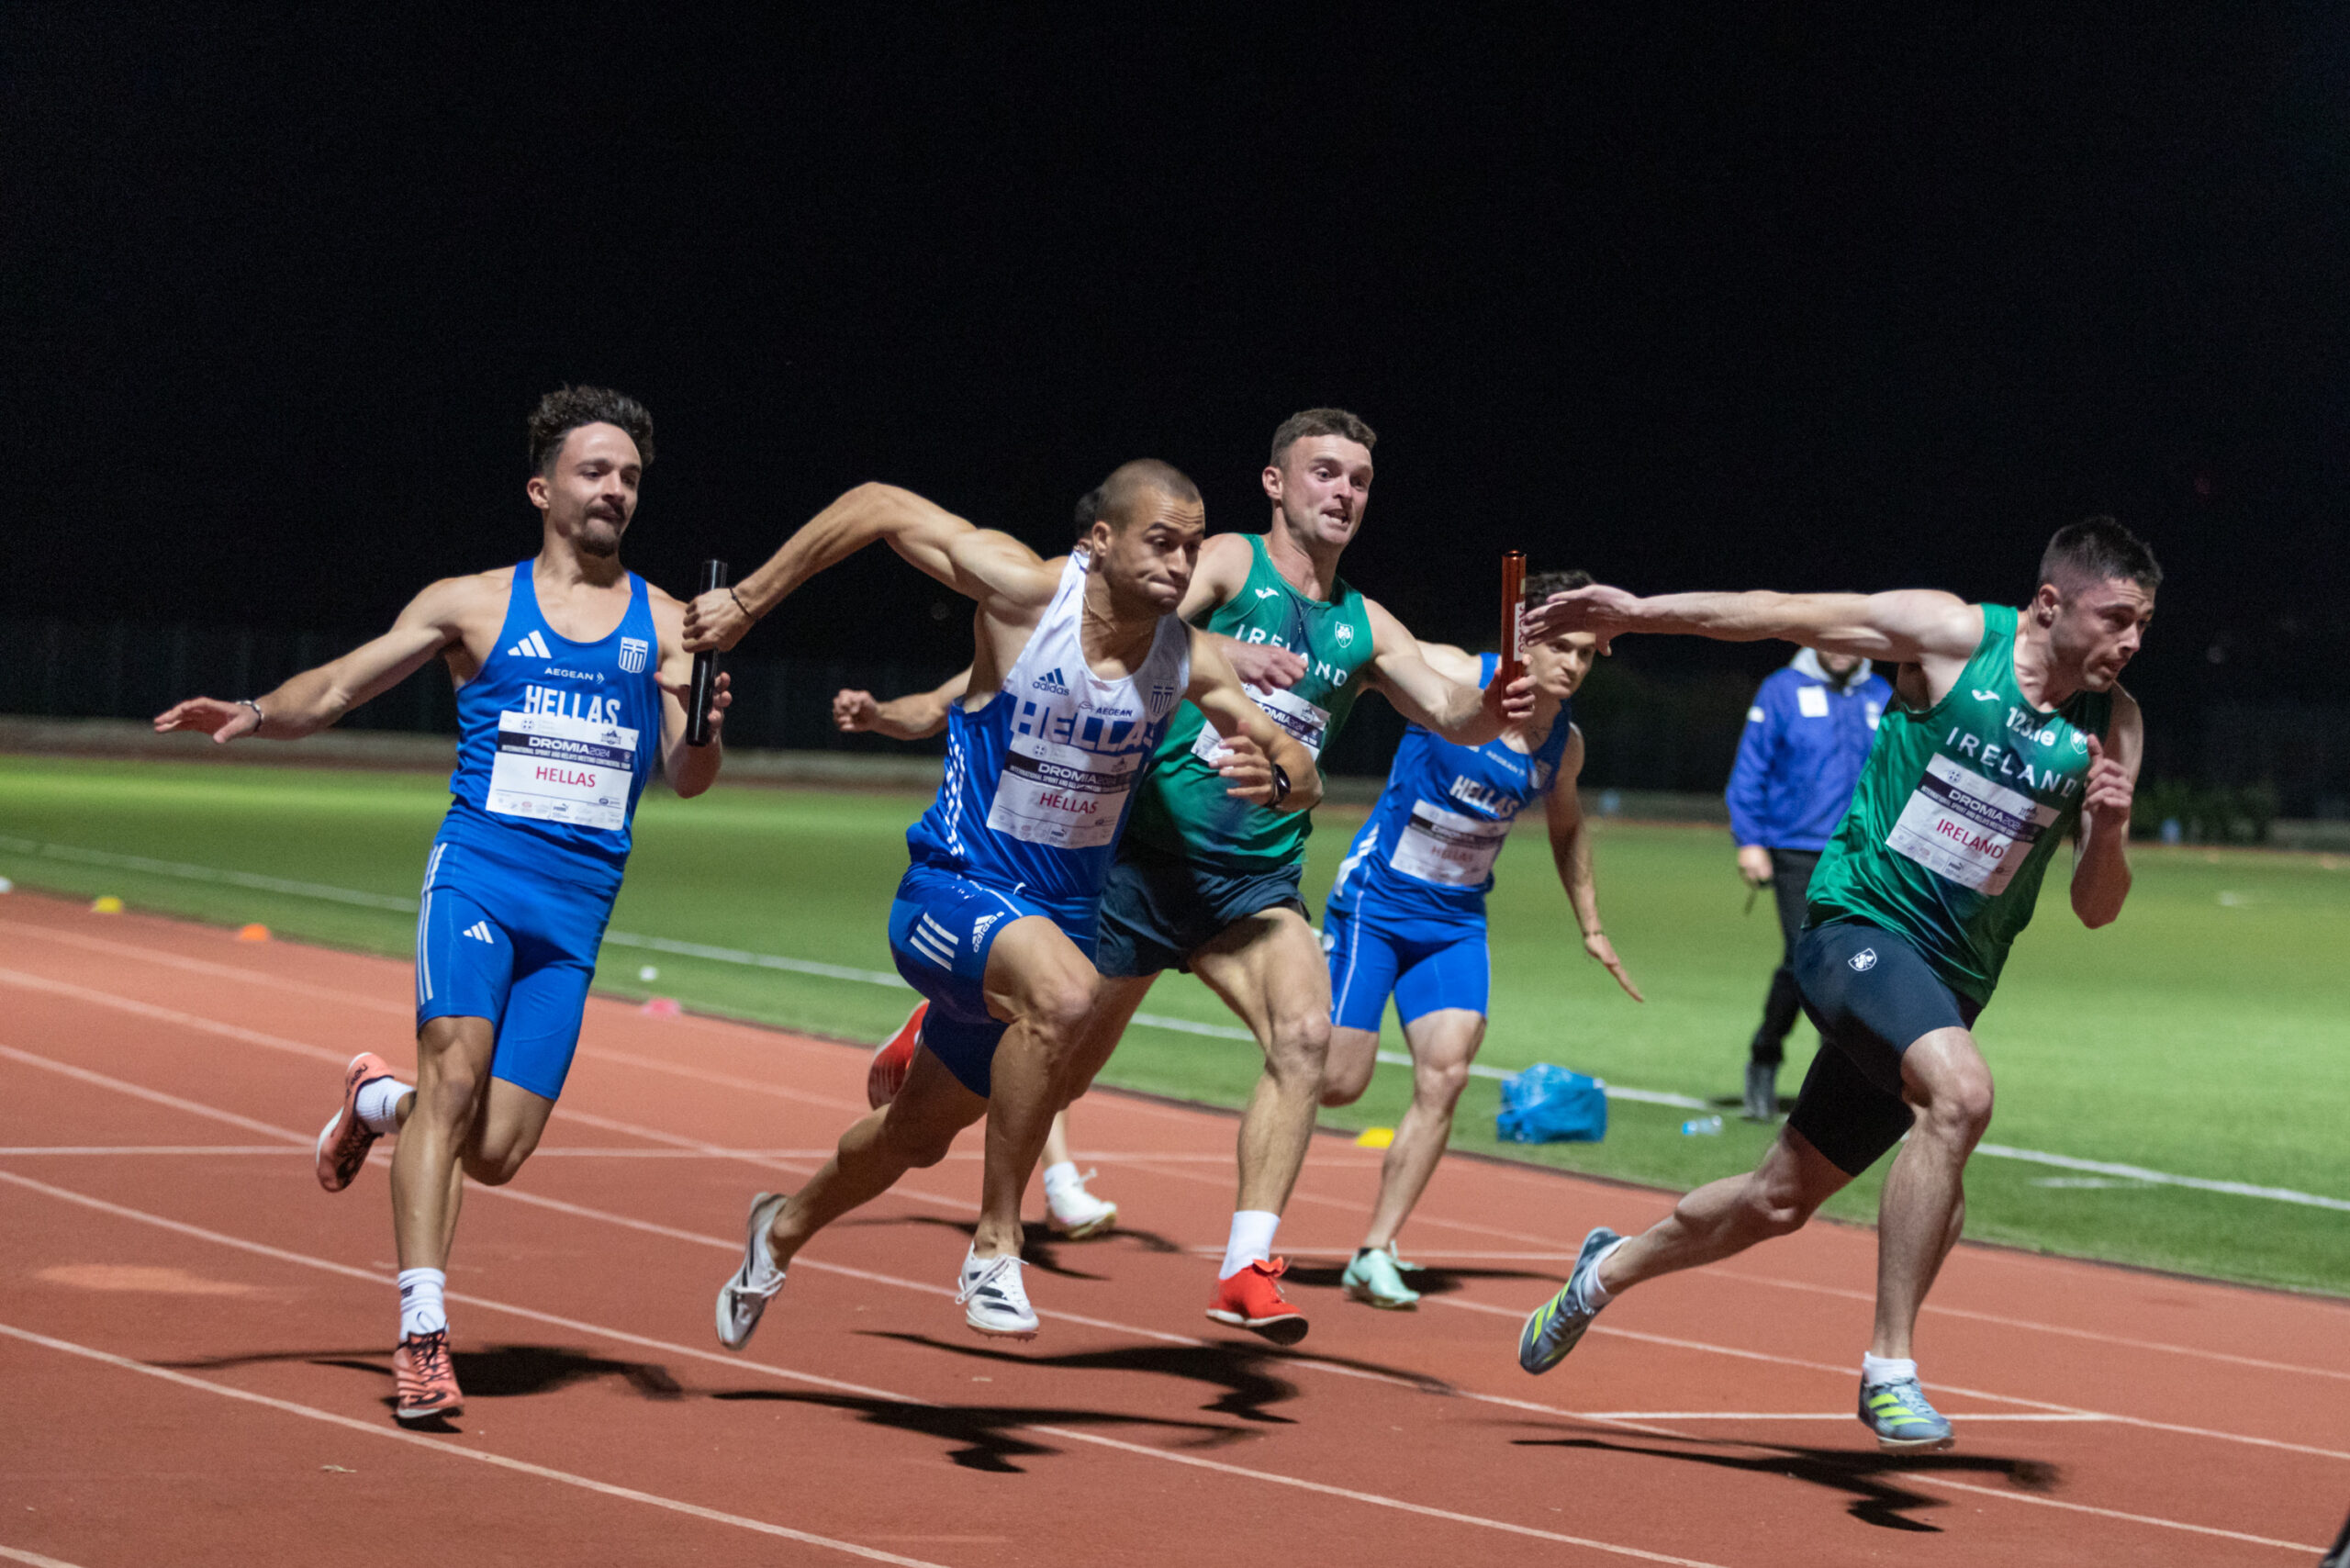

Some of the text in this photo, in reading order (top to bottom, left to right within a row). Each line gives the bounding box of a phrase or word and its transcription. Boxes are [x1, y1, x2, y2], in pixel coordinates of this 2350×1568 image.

[544, 667, 594, 681] AEGEAN
[1032, 680, 1070, 697] adidas
[523, 685, 621, 726] HELLAS
[1095, 707, 1133, 718] AEGEAN
[1256, 702, 1291, 725] OMIA
[528, 736, 589, 755] DROMIA
[589, 746, 610, 758] 2024
[1945, 726, 2077, 798] IRELAND
[535, 766, 597, 788] HELLAS
[1038, 764, 1097, 784] DROMIA
[1039, 792, 1100, 814] HELLAS
[1449, 775, 1519, 819] HELLAS
[1948, 789, 2004, 823] DROMIA
[1935, 818, 2005, 859] IRELAND
